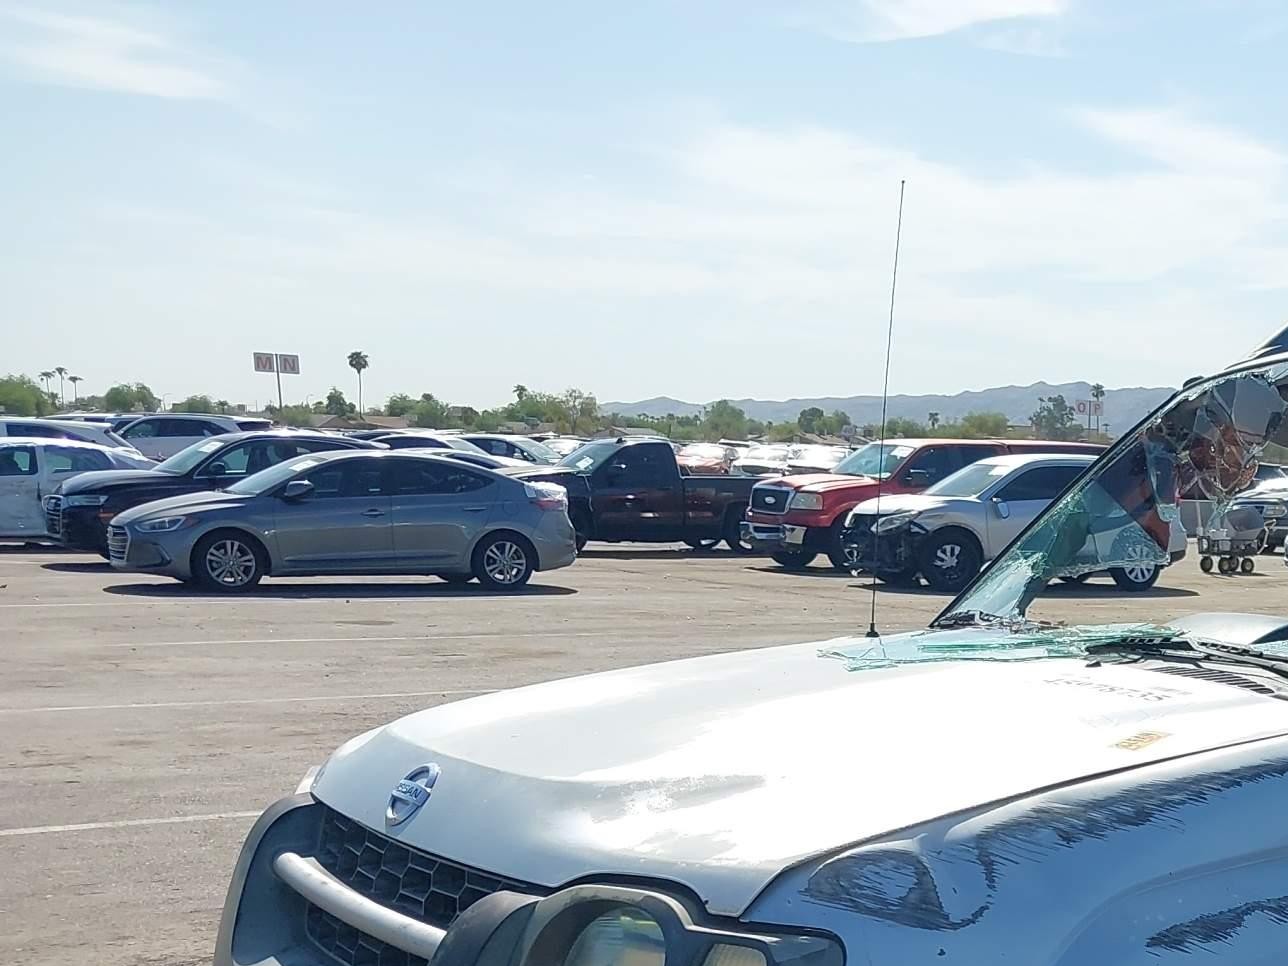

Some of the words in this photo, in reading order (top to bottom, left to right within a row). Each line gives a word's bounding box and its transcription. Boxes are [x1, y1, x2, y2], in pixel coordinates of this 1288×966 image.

[256, 356, 272, 369] M
[283, 357, 297, 371] N
[396, 782, 422, 799] SSAN
